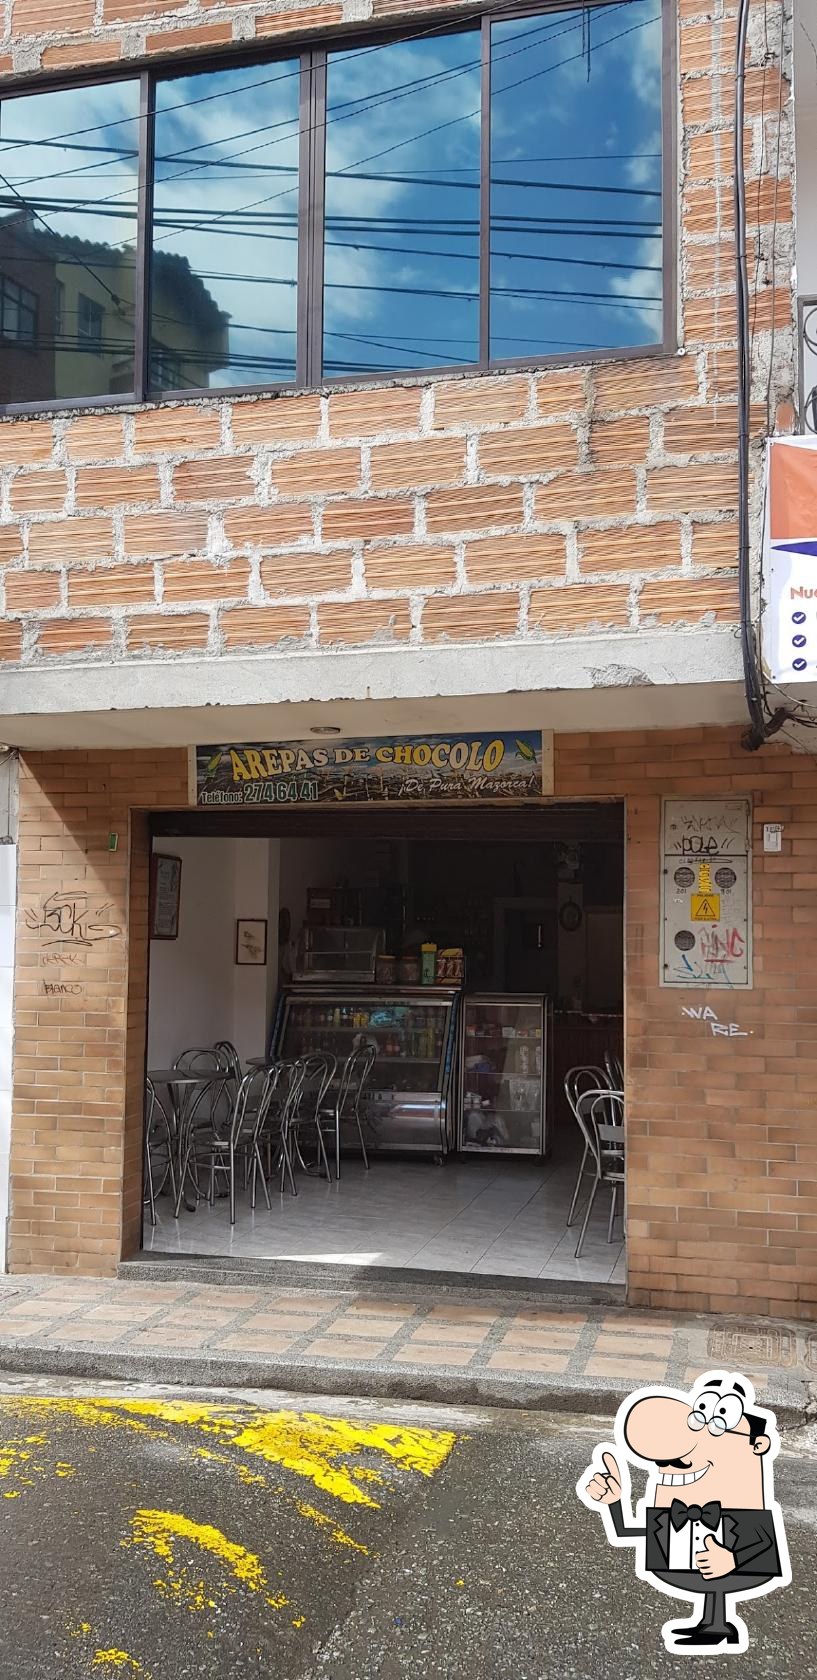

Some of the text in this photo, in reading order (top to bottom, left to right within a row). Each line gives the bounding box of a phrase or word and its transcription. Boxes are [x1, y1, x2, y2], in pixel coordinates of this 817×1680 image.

[229, 739, 505, 782] AREPAS DE CHOCOLO
[430, 778, 462, 792] Pura
[468, 775, 535, 793] Mazorca!
